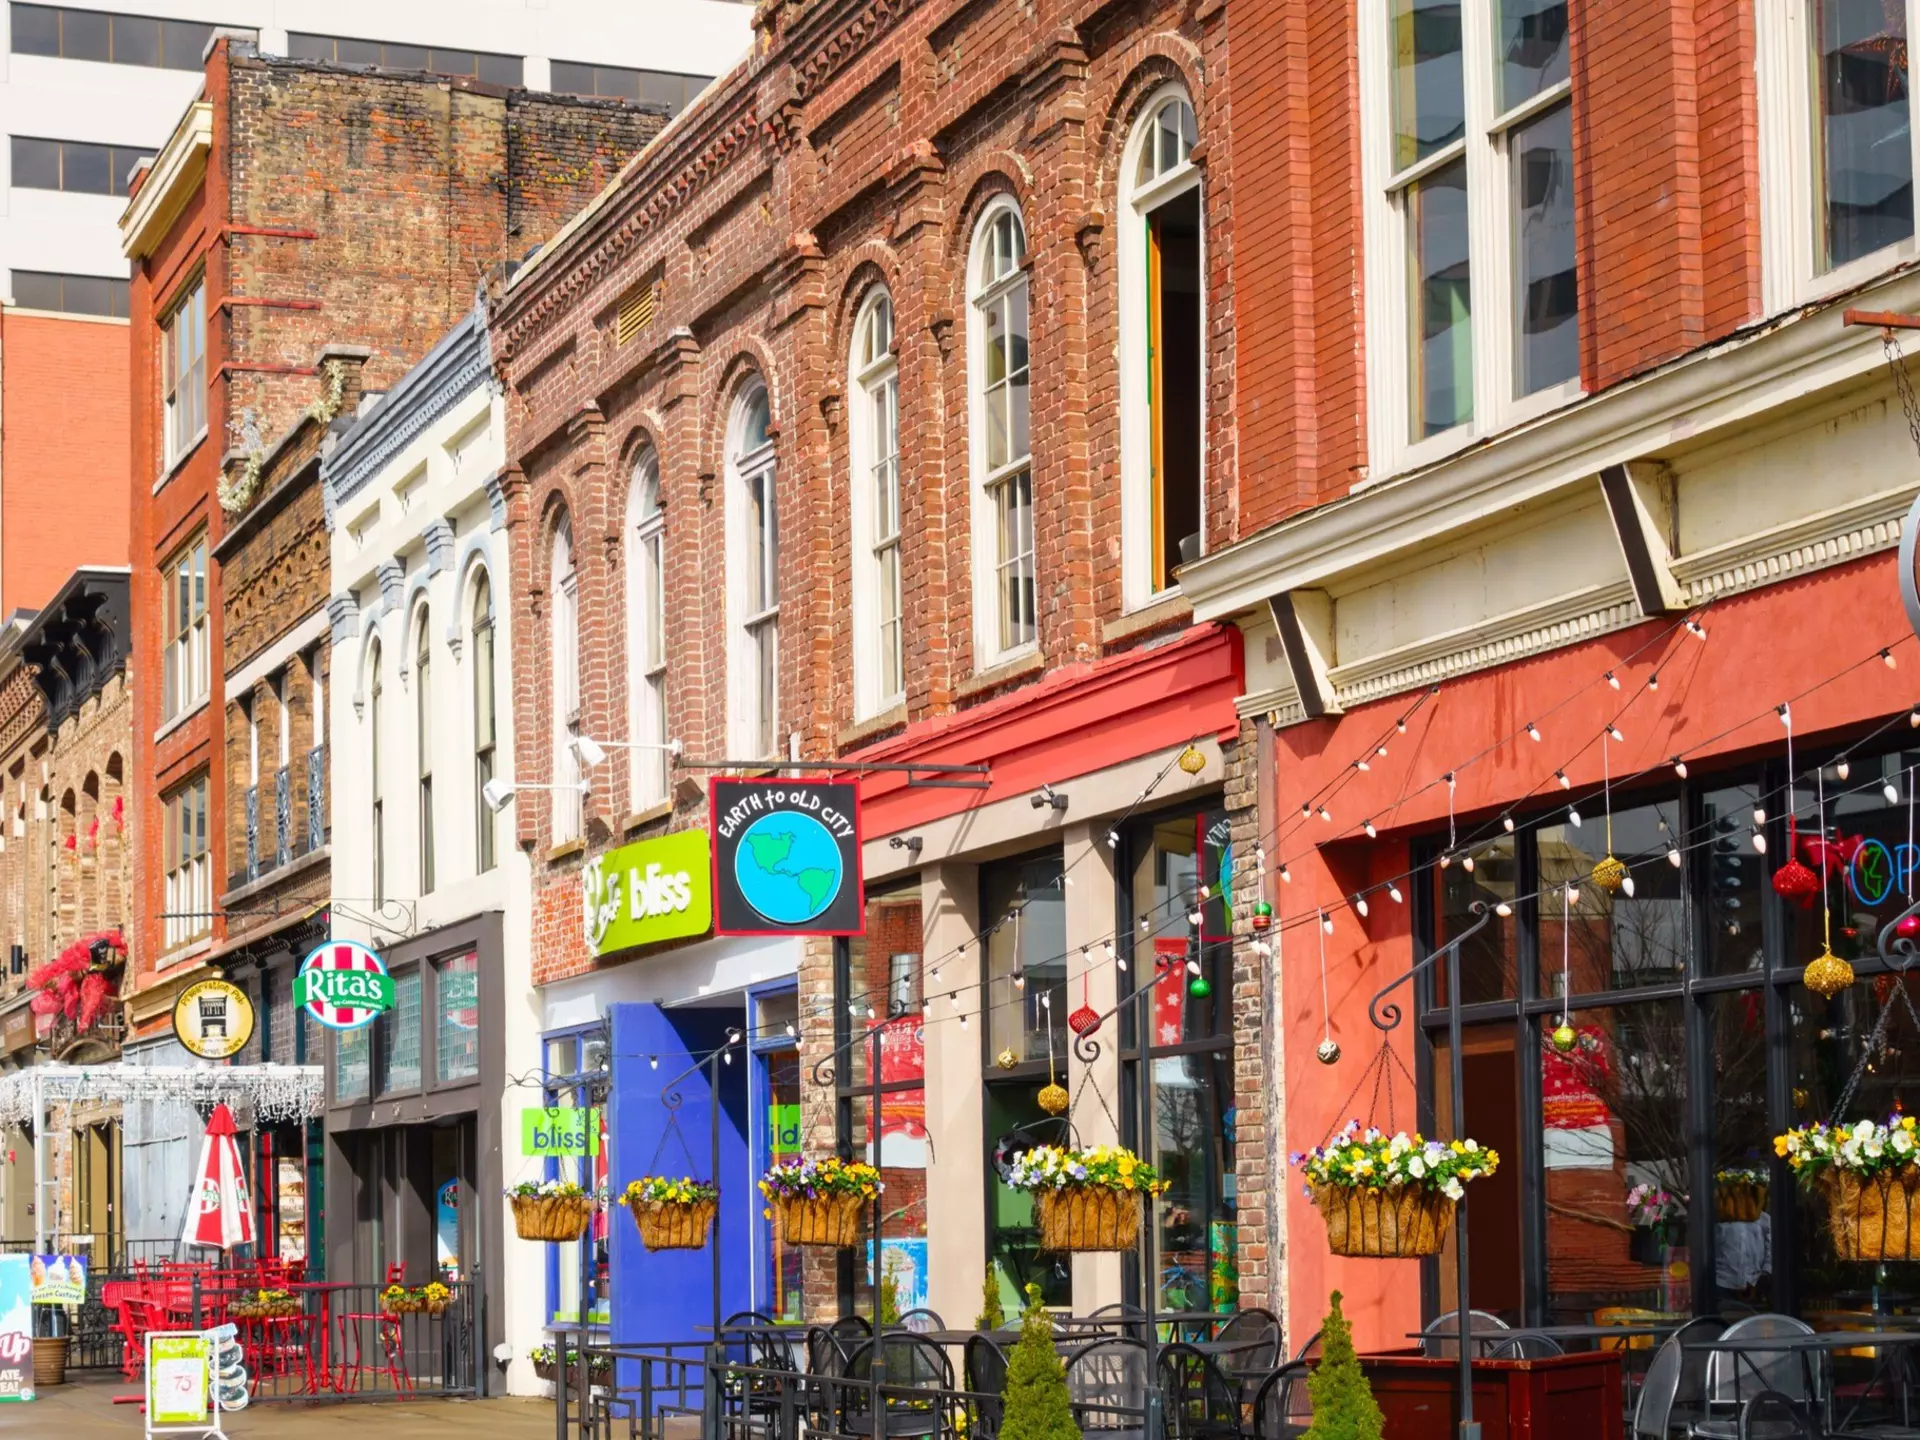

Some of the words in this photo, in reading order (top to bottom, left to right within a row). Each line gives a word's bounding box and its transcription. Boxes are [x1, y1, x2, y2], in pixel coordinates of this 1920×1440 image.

[718, 793, 763, 838] EARTH
[765, 789, 785, 810] to
[789, 790, 820, 810] OLD
[821, 807, 855, 838] CITY
[629, 863, 691, 919] bliss
[305, 968, 383, 1003] Rita's
[533, 1126, 586, 1149] bliss
[0, 1382, 19, 1393] EA!
